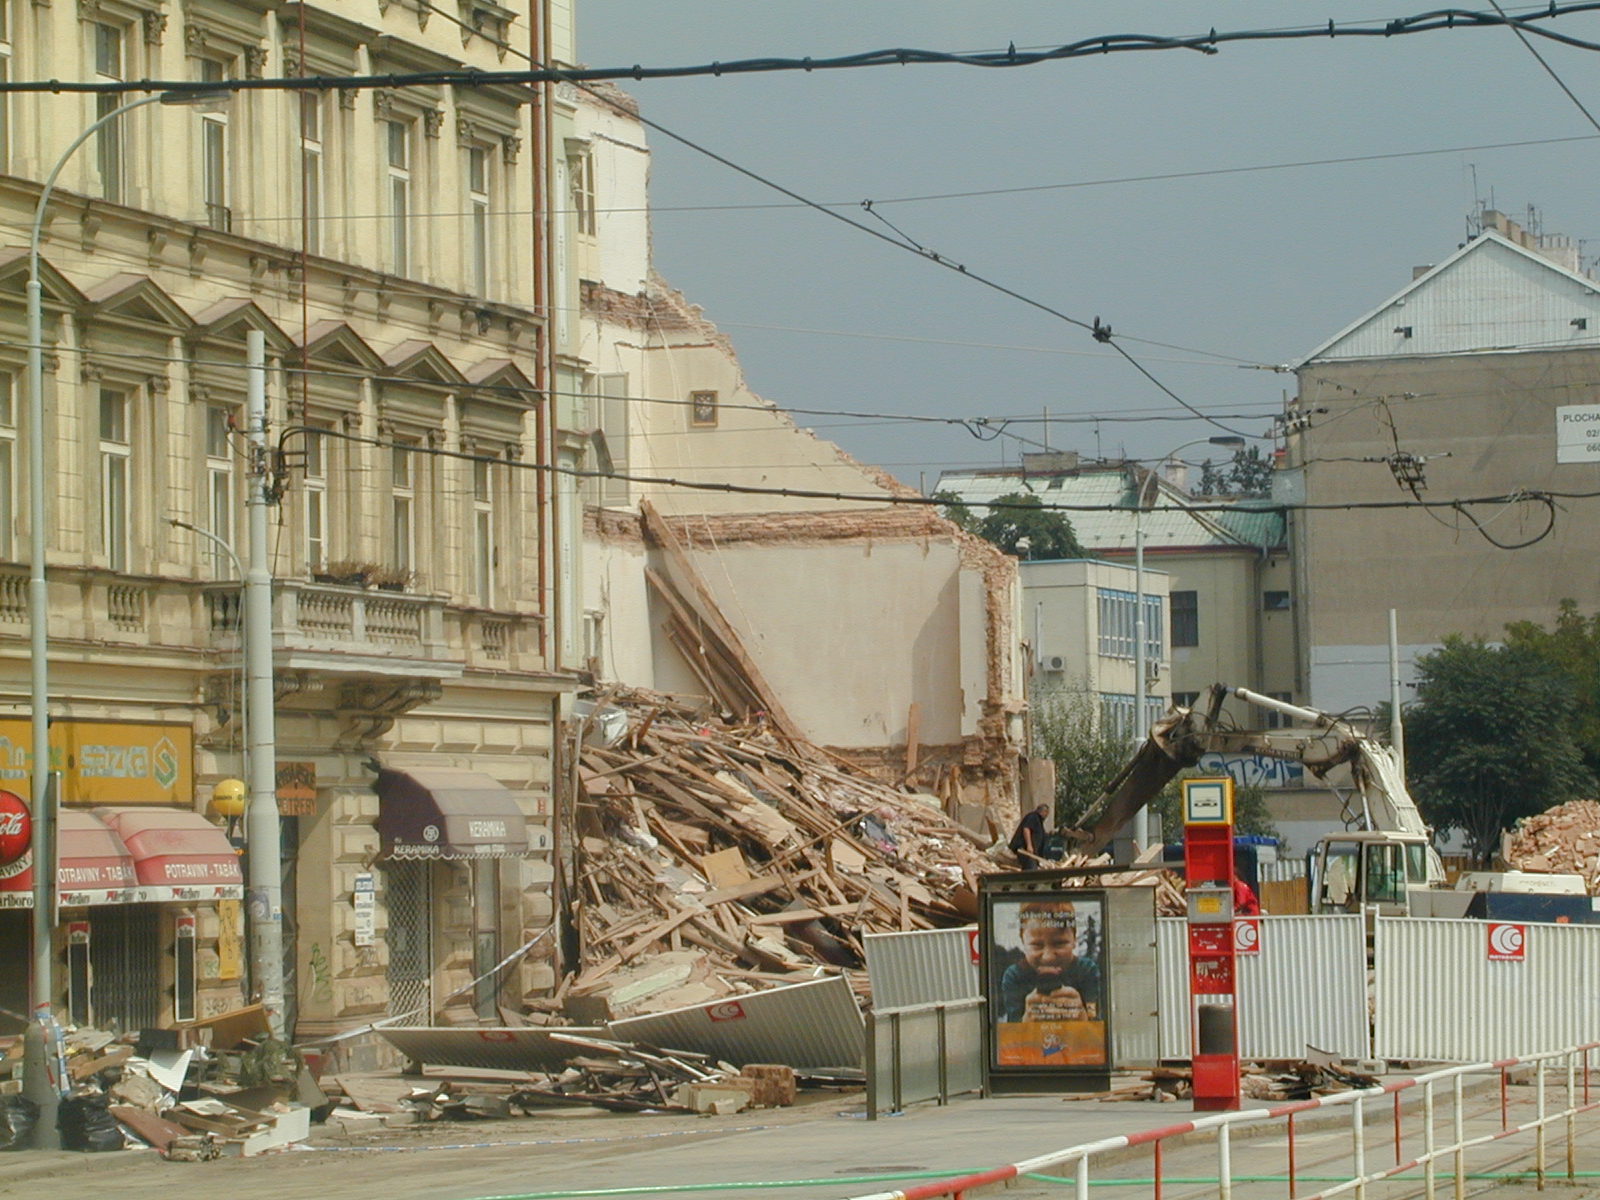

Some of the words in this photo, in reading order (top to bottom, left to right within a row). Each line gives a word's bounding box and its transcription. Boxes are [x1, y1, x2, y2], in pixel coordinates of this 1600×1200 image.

[0, 812, 26, 835] ola
[58, 867, 100, 884] OTRAVINY
[164, 863, 209, 879] POTRAVINY
